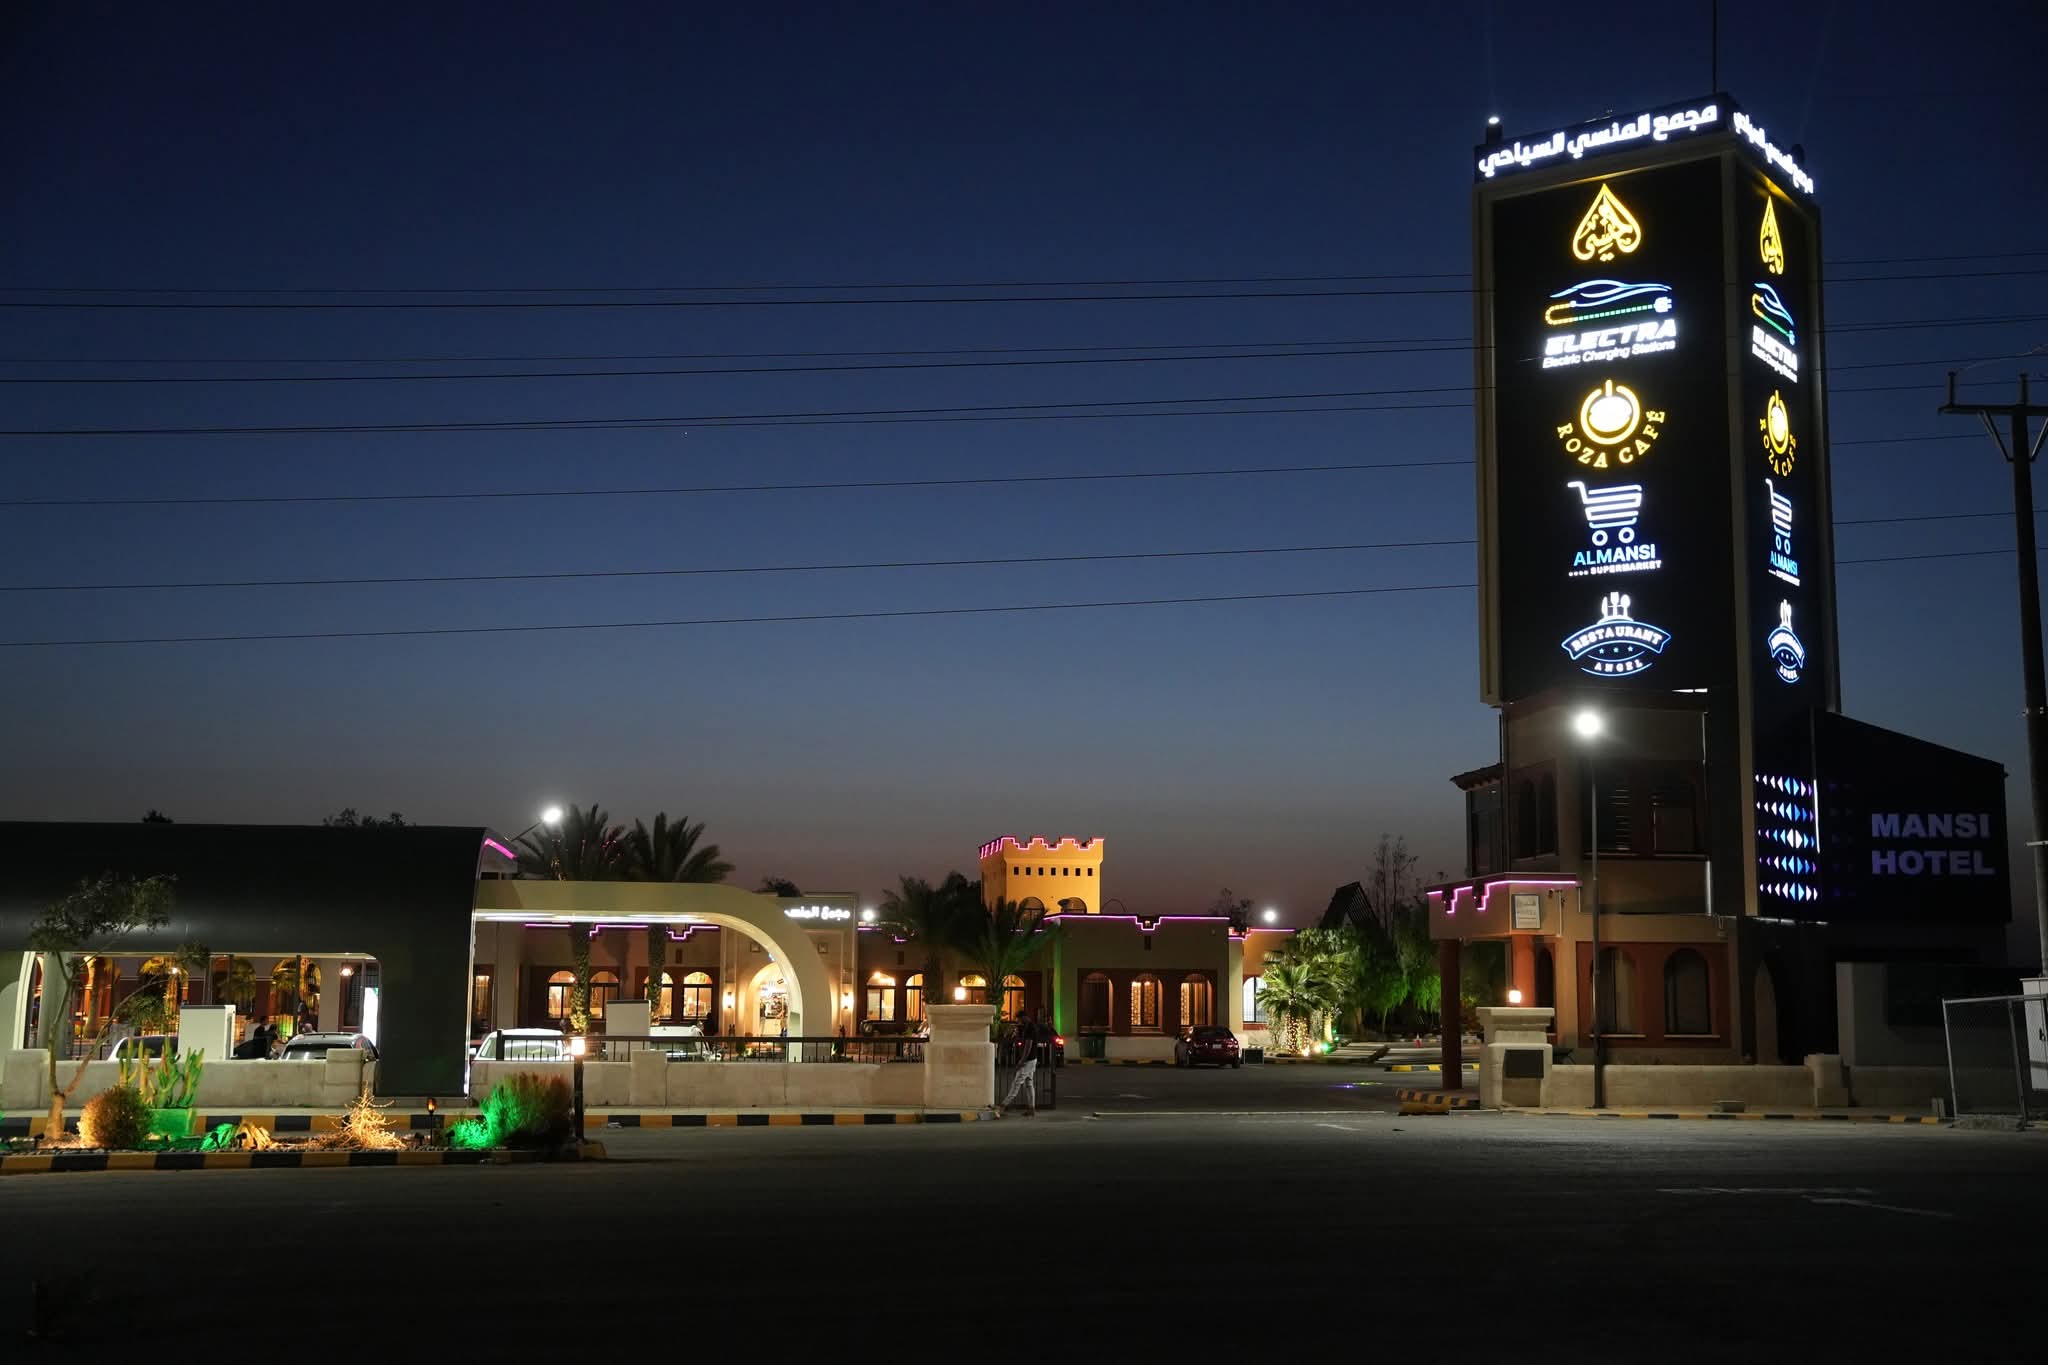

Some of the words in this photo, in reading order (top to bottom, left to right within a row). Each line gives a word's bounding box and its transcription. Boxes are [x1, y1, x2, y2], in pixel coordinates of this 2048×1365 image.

[1567, 113, 1651, 159] المنسي
[1653, 105, 1718, 141] مجمع
[1478, 132, 1566, 178] السياحي
[1545, 318, 1677, 356] ELECTRA
[1542, 354, 1581, 369] Electric
[1582, 346, 1631, 361] Charging
[1632, 339, 1676, 355] Stations
[1557, 422, 1608, 468] ROZA
[1573, 543, 1656, 566] ALMANSI
[1590, 559, 1662, 575] SUPERMARKET
[1571, 625, 1663, 652] RESTAURANT
[1594, 659, 1643, 673] ANGEL
[1871, 813, 1991, 838] MANSI
[1871, 849, 1995, 875] HOTEL
[783, 905, 820, 919] المنس
